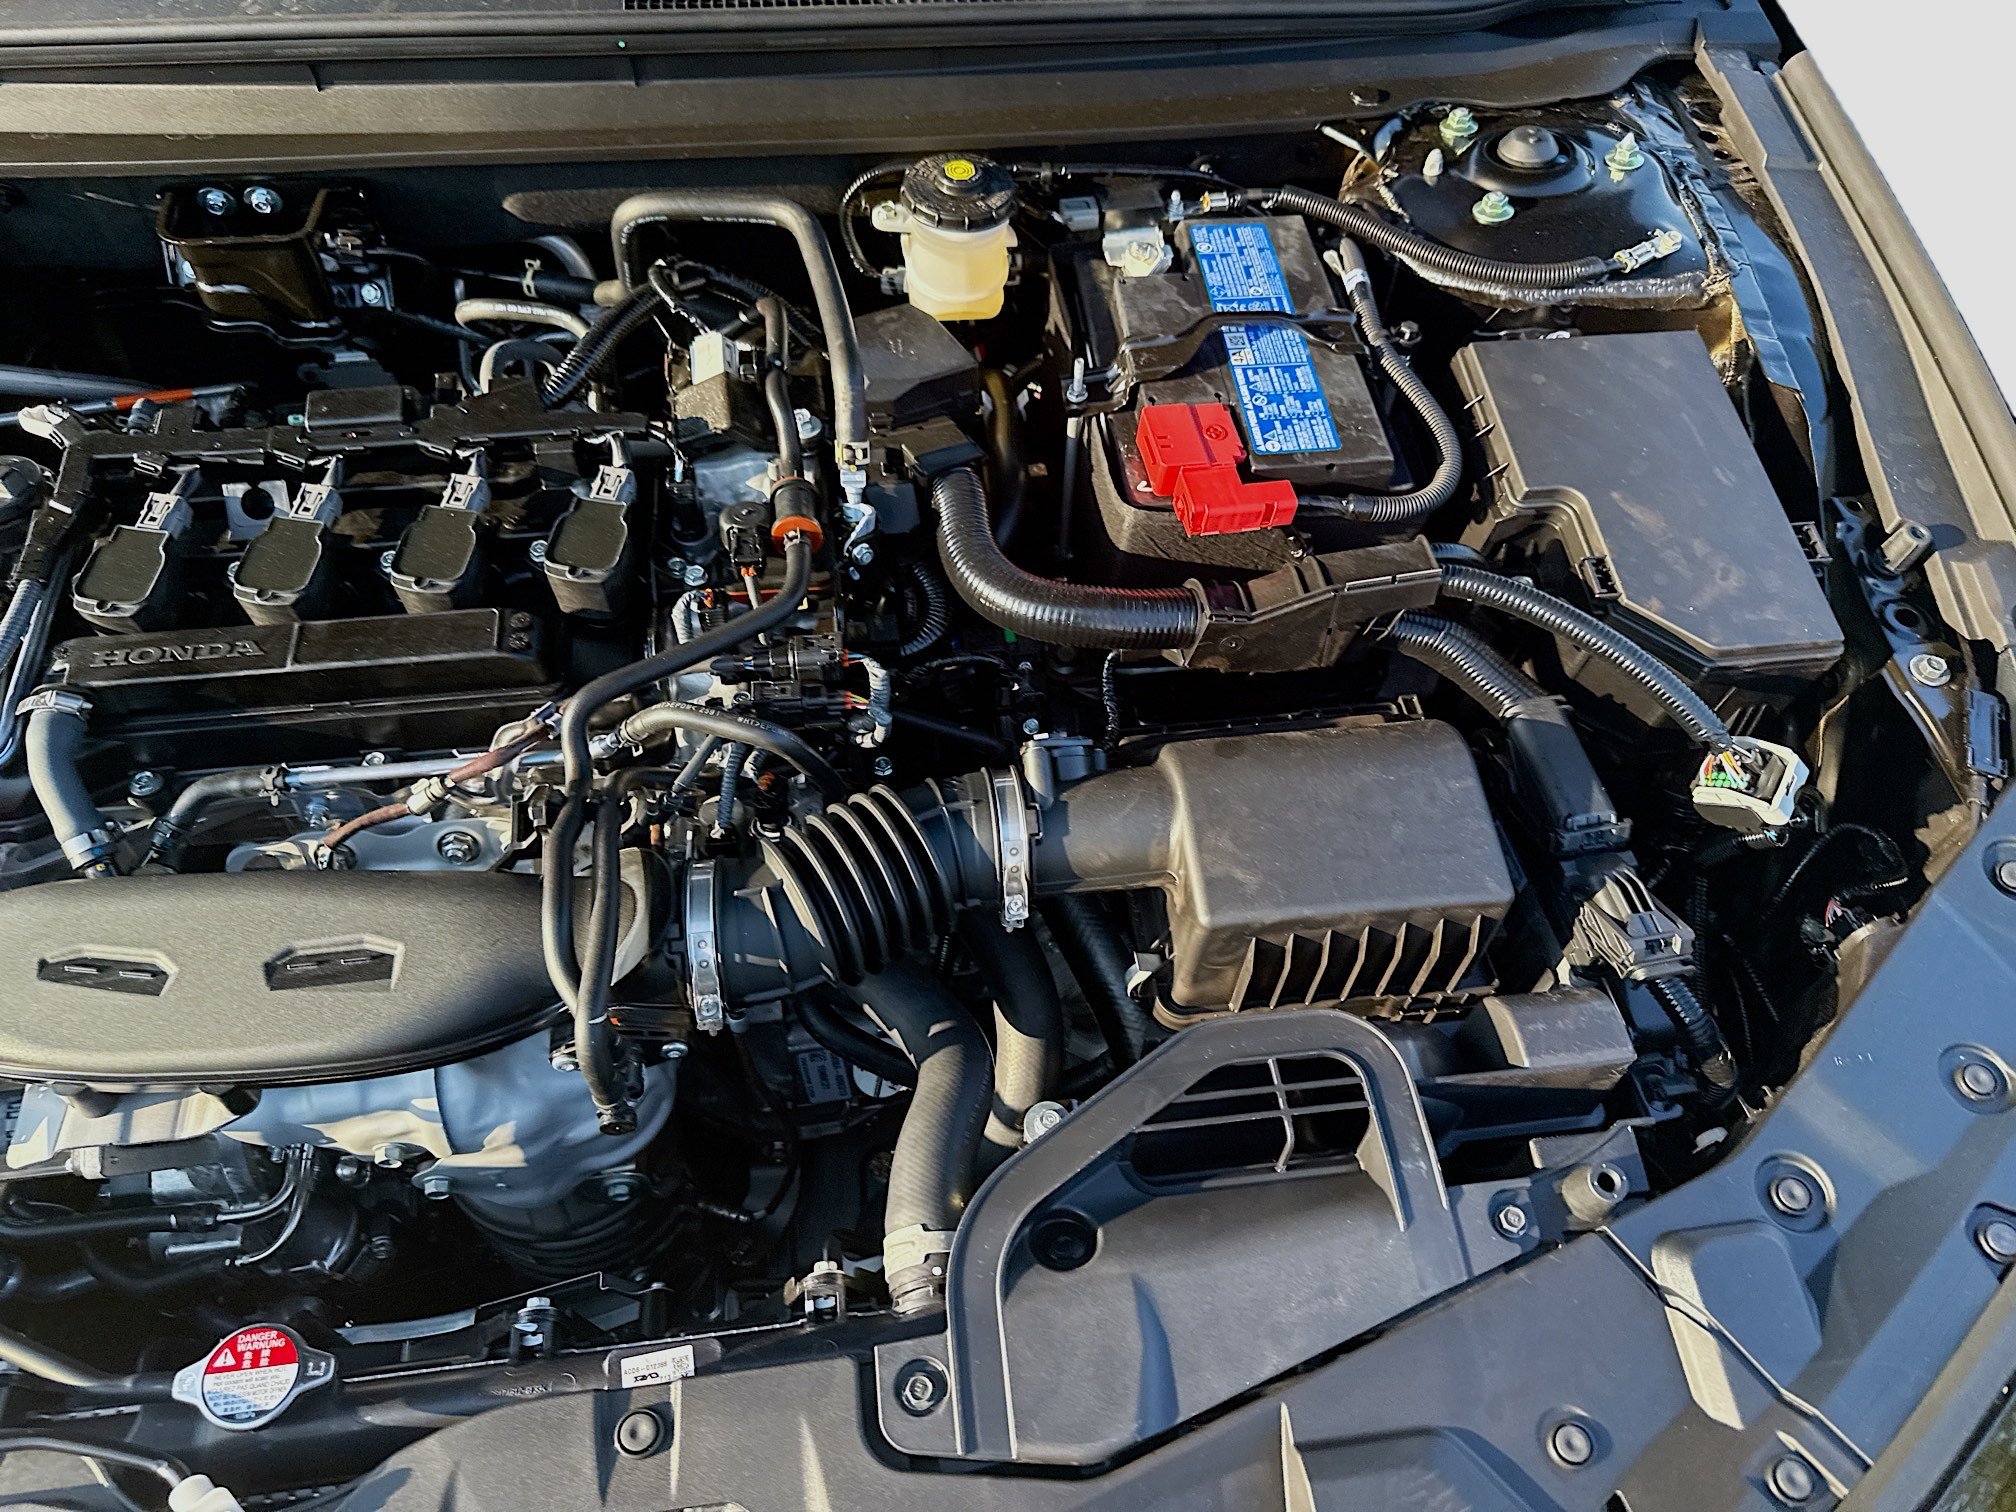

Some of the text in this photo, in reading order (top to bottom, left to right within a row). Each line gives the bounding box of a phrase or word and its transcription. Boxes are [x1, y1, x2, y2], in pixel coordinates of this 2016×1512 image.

[90, 640, 266, 668] HONDA
[238, 1330, 278, 1344] DANGER
[237, 1338, 286, 1352] WARNUNG
